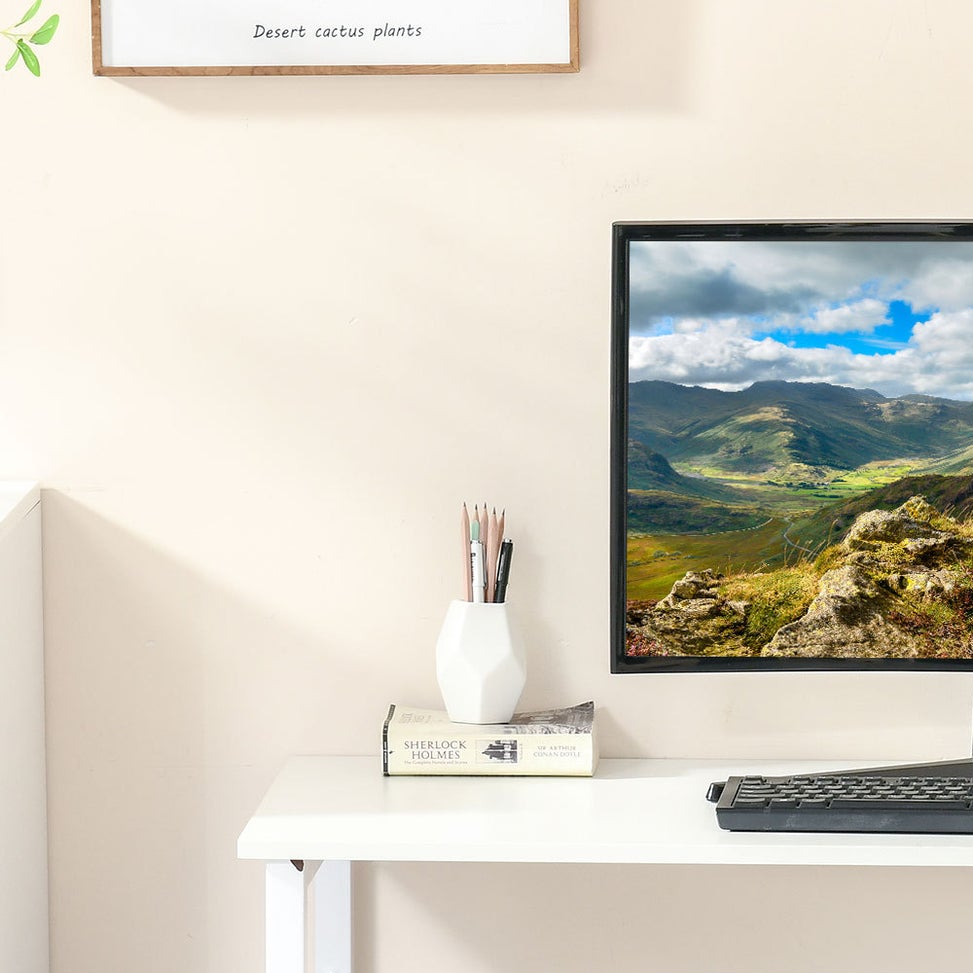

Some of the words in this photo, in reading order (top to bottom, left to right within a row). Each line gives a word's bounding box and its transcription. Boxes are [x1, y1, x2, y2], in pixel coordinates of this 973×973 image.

[253, 24, 306, 38] Desert
[315, 25, 365, 38] cactus
[373, 23, 422, 41] plants
[404, 740, 467, 750] SHERLOCK
[412, 750, 460, 760] HOLMES
